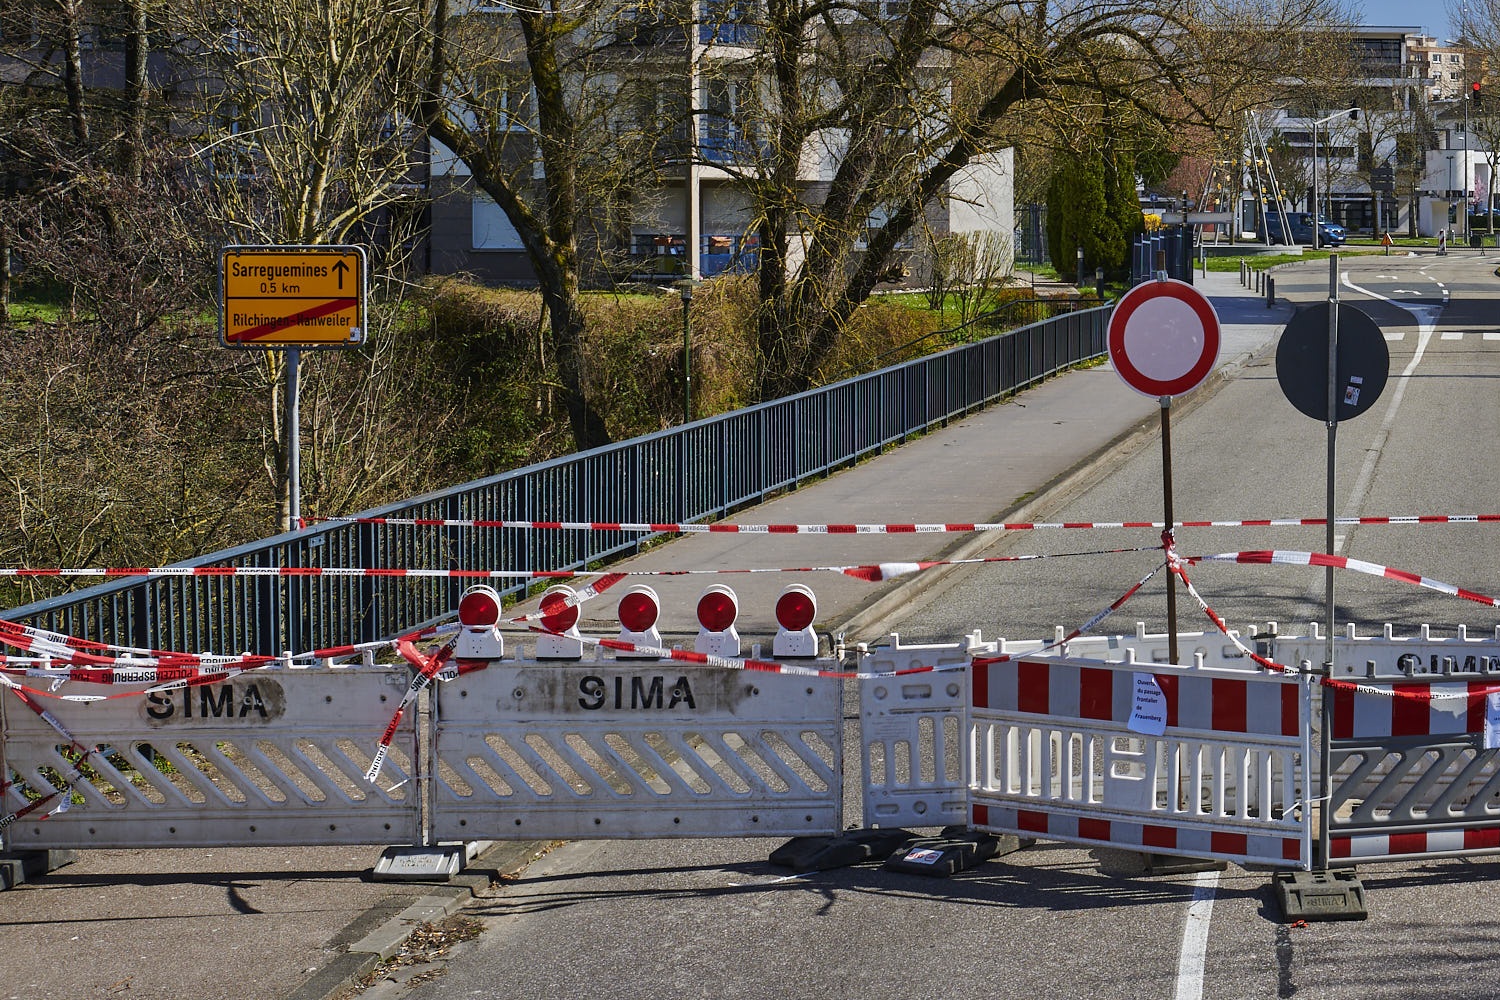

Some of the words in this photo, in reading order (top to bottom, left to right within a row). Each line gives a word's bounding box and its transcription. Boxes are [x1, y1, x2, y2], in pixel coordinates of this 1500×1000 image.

[232, 262, 328, 280] Sarreguemines
[282, 283, 300, 293] km
[233, 313, 351, 329] Rilchingen-Hanweiler
[102, 669, 193, 683] POLIZEIABSPERRUNG
[578, 675, 696, 710] SIMA
[146, 683, 268, 720] SIMA
